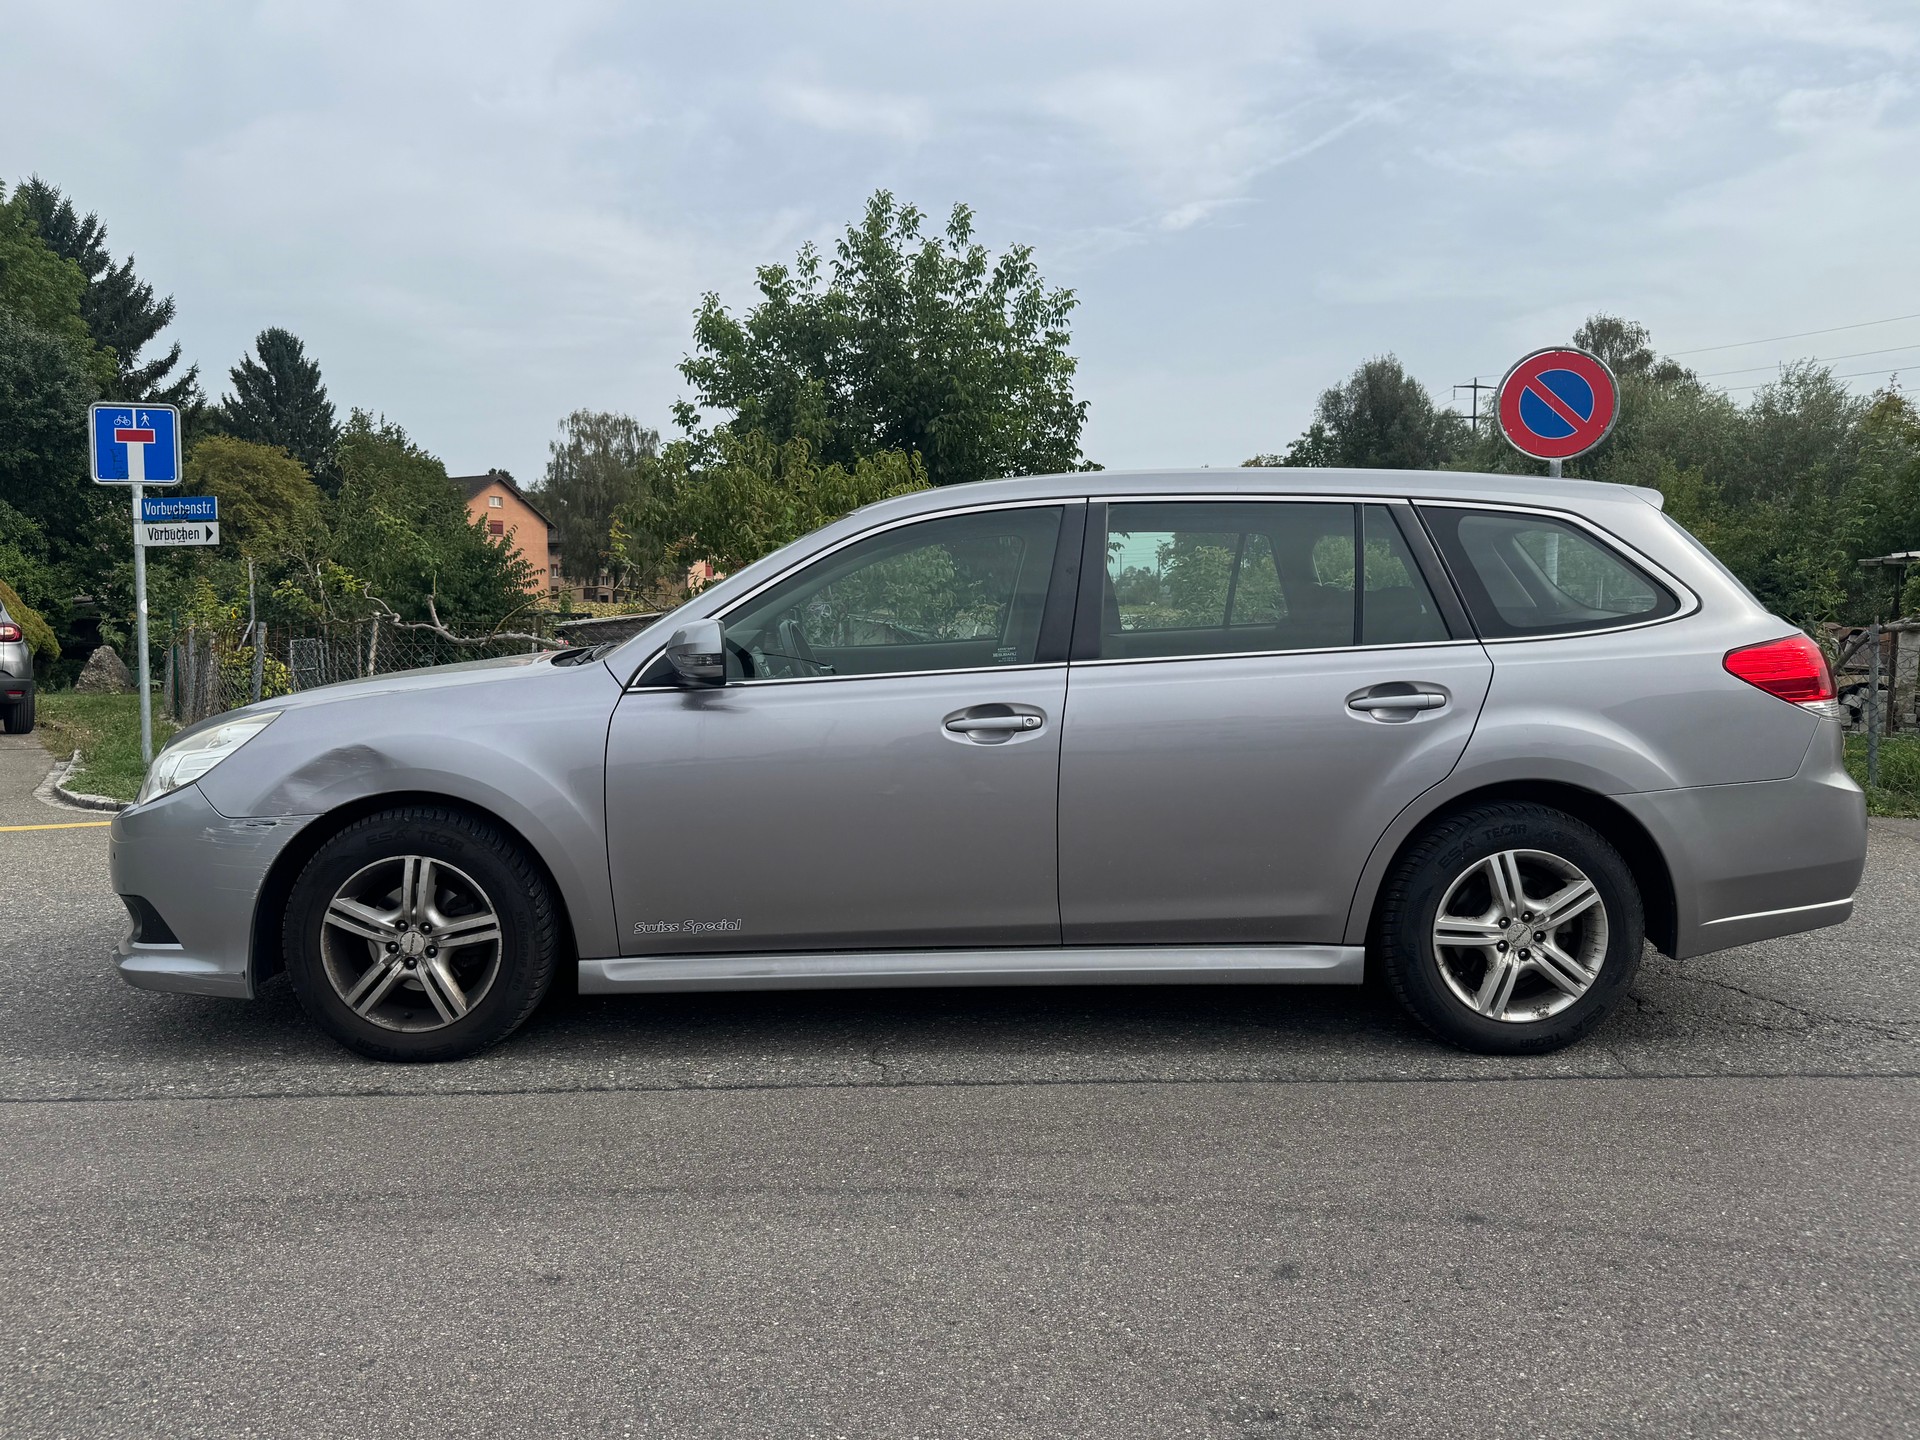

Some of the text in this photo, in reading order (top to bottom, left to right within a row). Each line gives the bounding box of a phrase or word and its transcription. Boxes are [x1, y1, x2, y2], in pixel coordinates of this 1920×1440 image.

[144, 501, 213, 516] Vorbuchenstr.
[1482, 823, 1528, 841] TECAR
[419, 831, 464, 851] TECAR
[633, 919, 742, 935] Swiss Special
